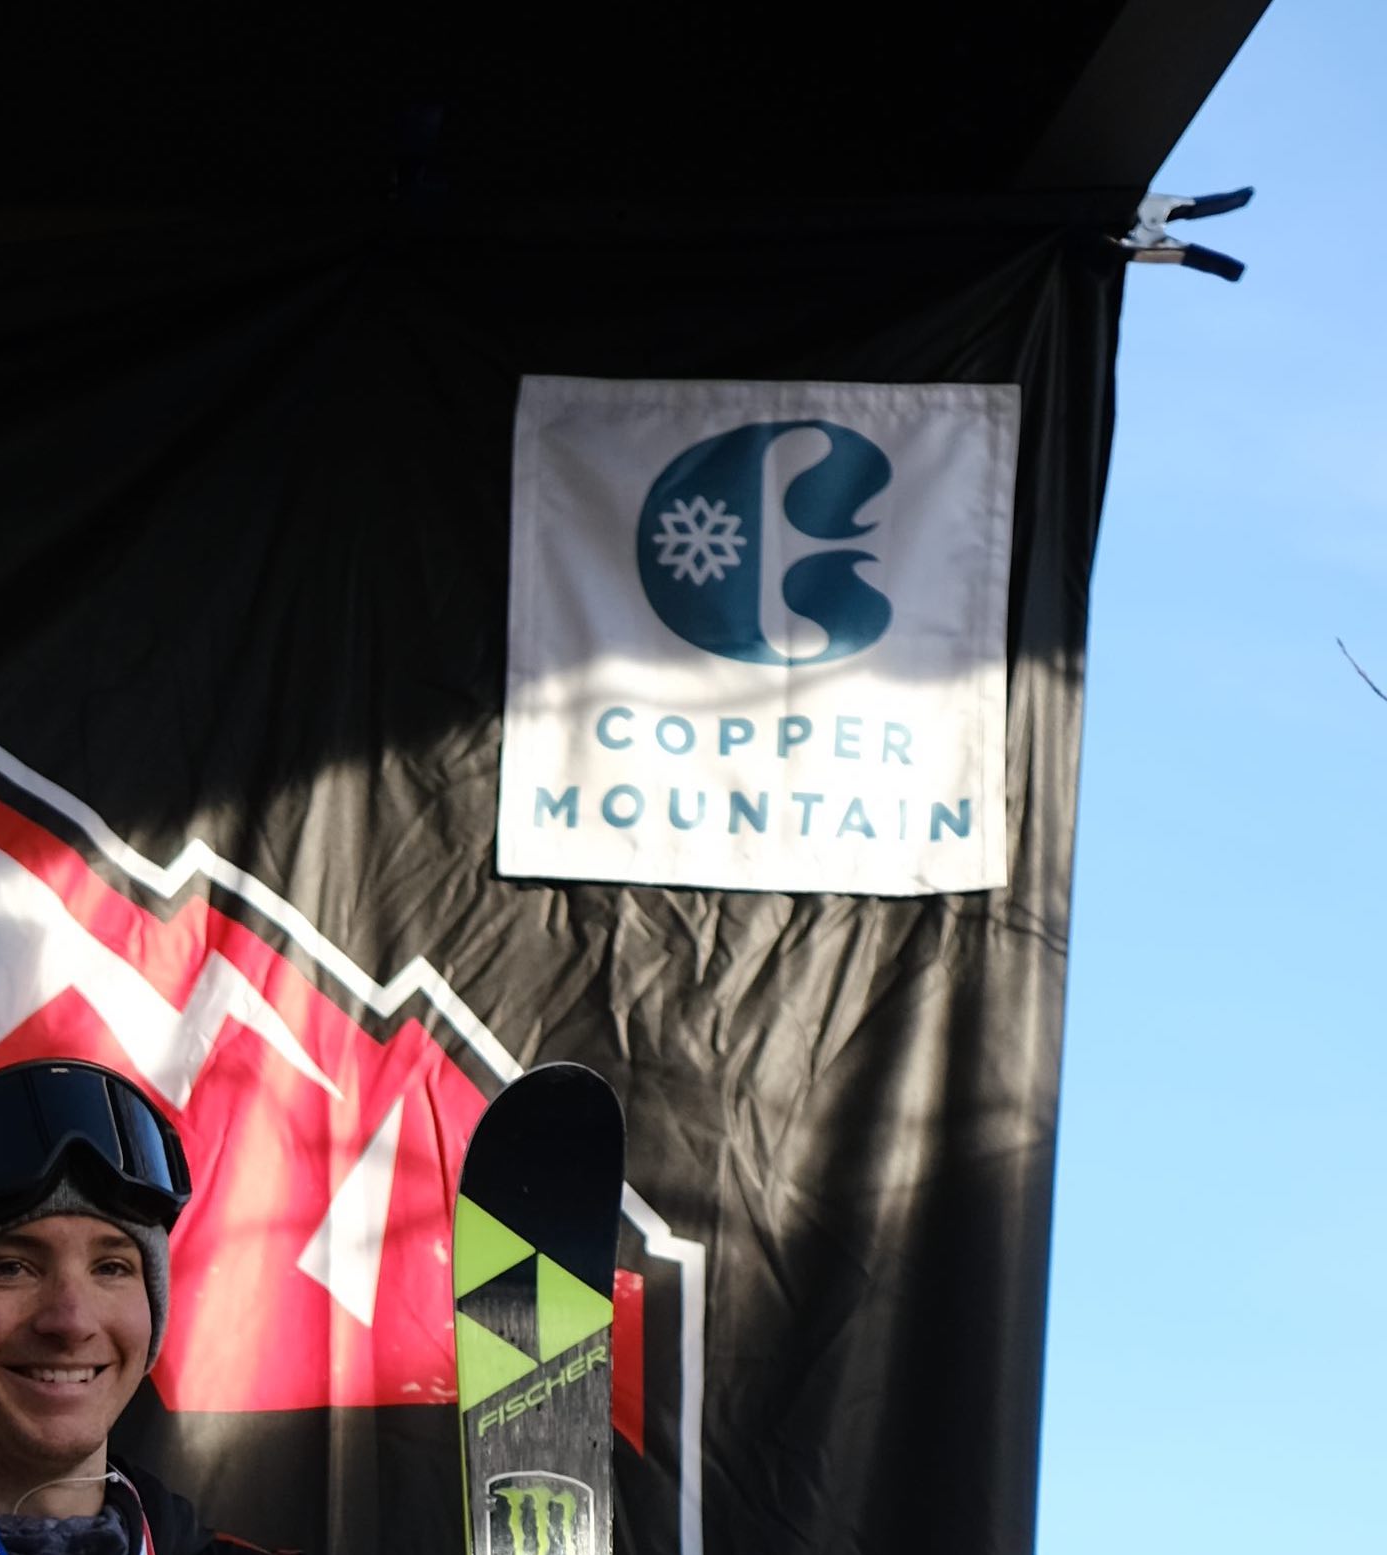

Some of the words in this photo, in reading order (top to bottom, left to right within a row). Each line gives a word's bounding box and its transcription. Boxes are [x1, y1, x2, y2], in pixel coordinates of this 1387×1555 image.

[595, 706, 914, 766] COPPER
[532, 783, 973, 843] MOUNTAIN
[478, 1345, 608, 1438] FISCHER
